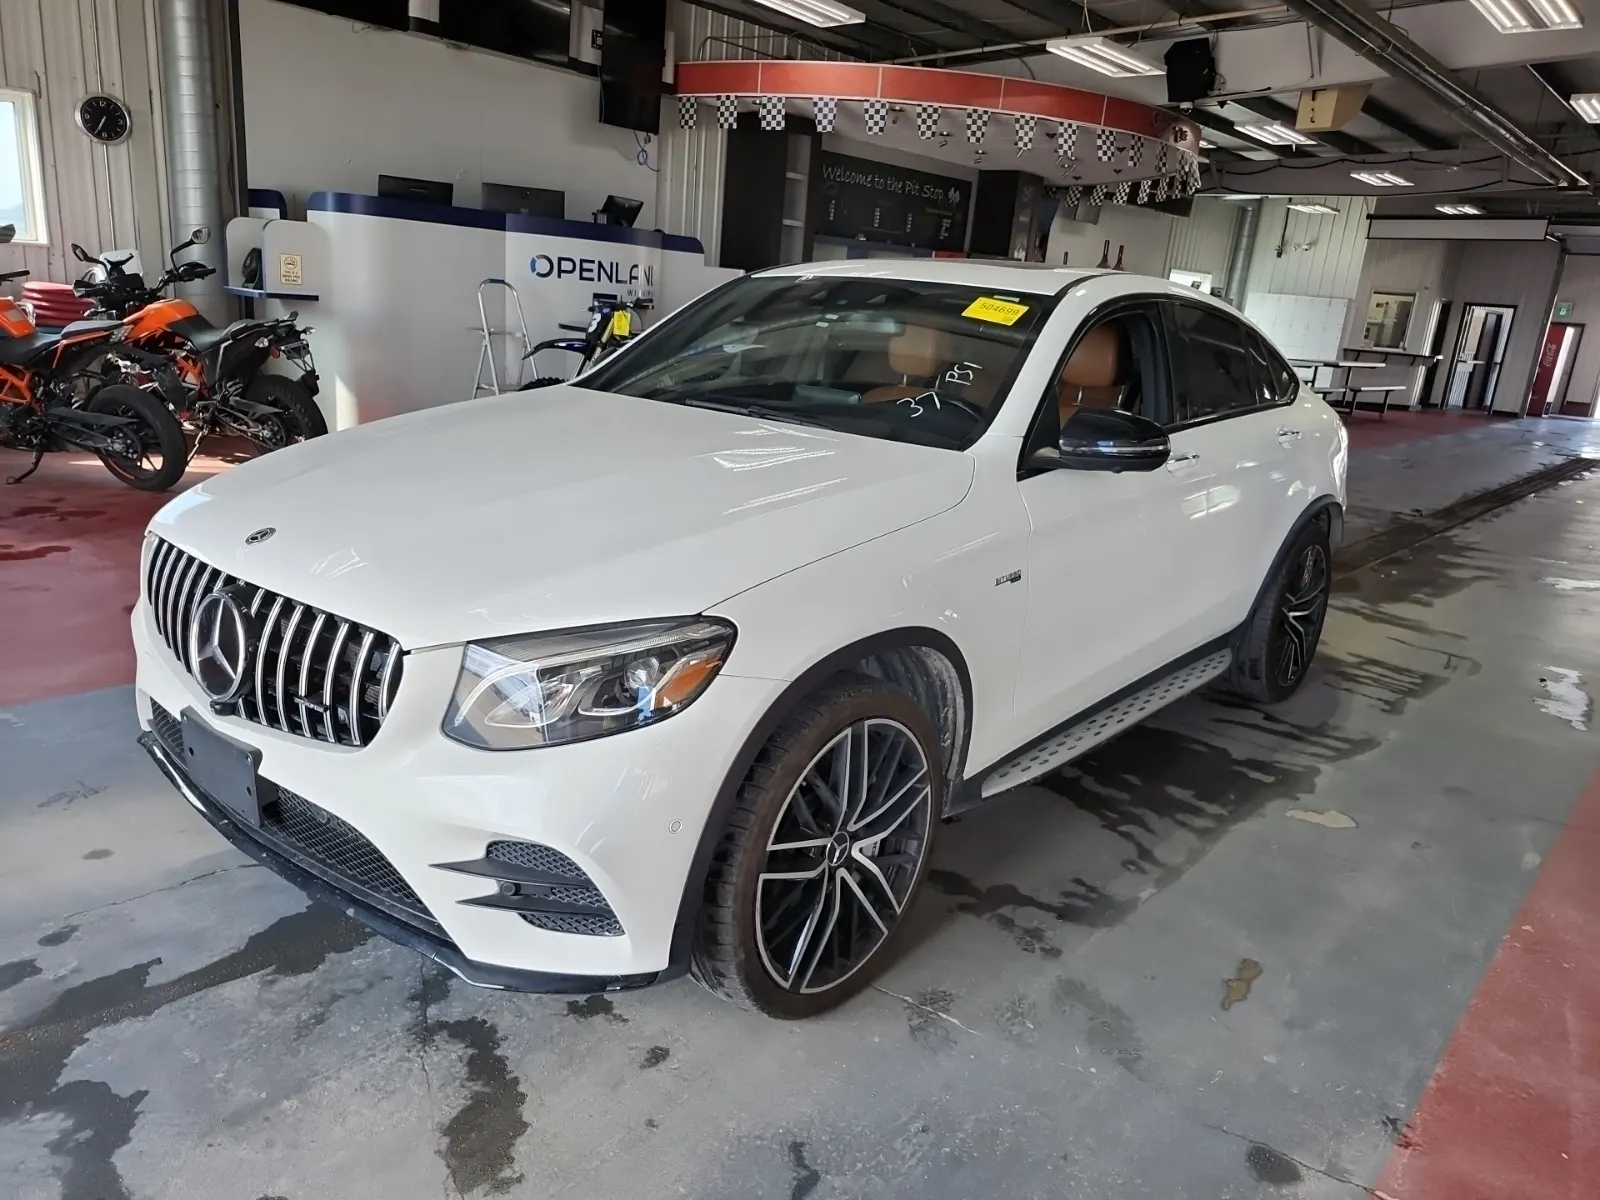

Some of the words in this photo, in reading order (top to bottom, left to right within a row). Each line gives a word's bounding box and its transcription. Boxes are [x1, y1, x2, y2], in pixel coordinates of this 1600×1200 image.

[99, 100, 107, 108] 12
[822, 164, 872, 188] Welcome
[874, 174, 884, 190] to
[887, 176, 903, 194] the
[905, 179, 920, 196] Pit
[921, 184, 944, 205] Stop
[980, 302, 1020, 316] 504699
[896, 390, 940, 418] 37
[945, 361, 983, 386] PSI
